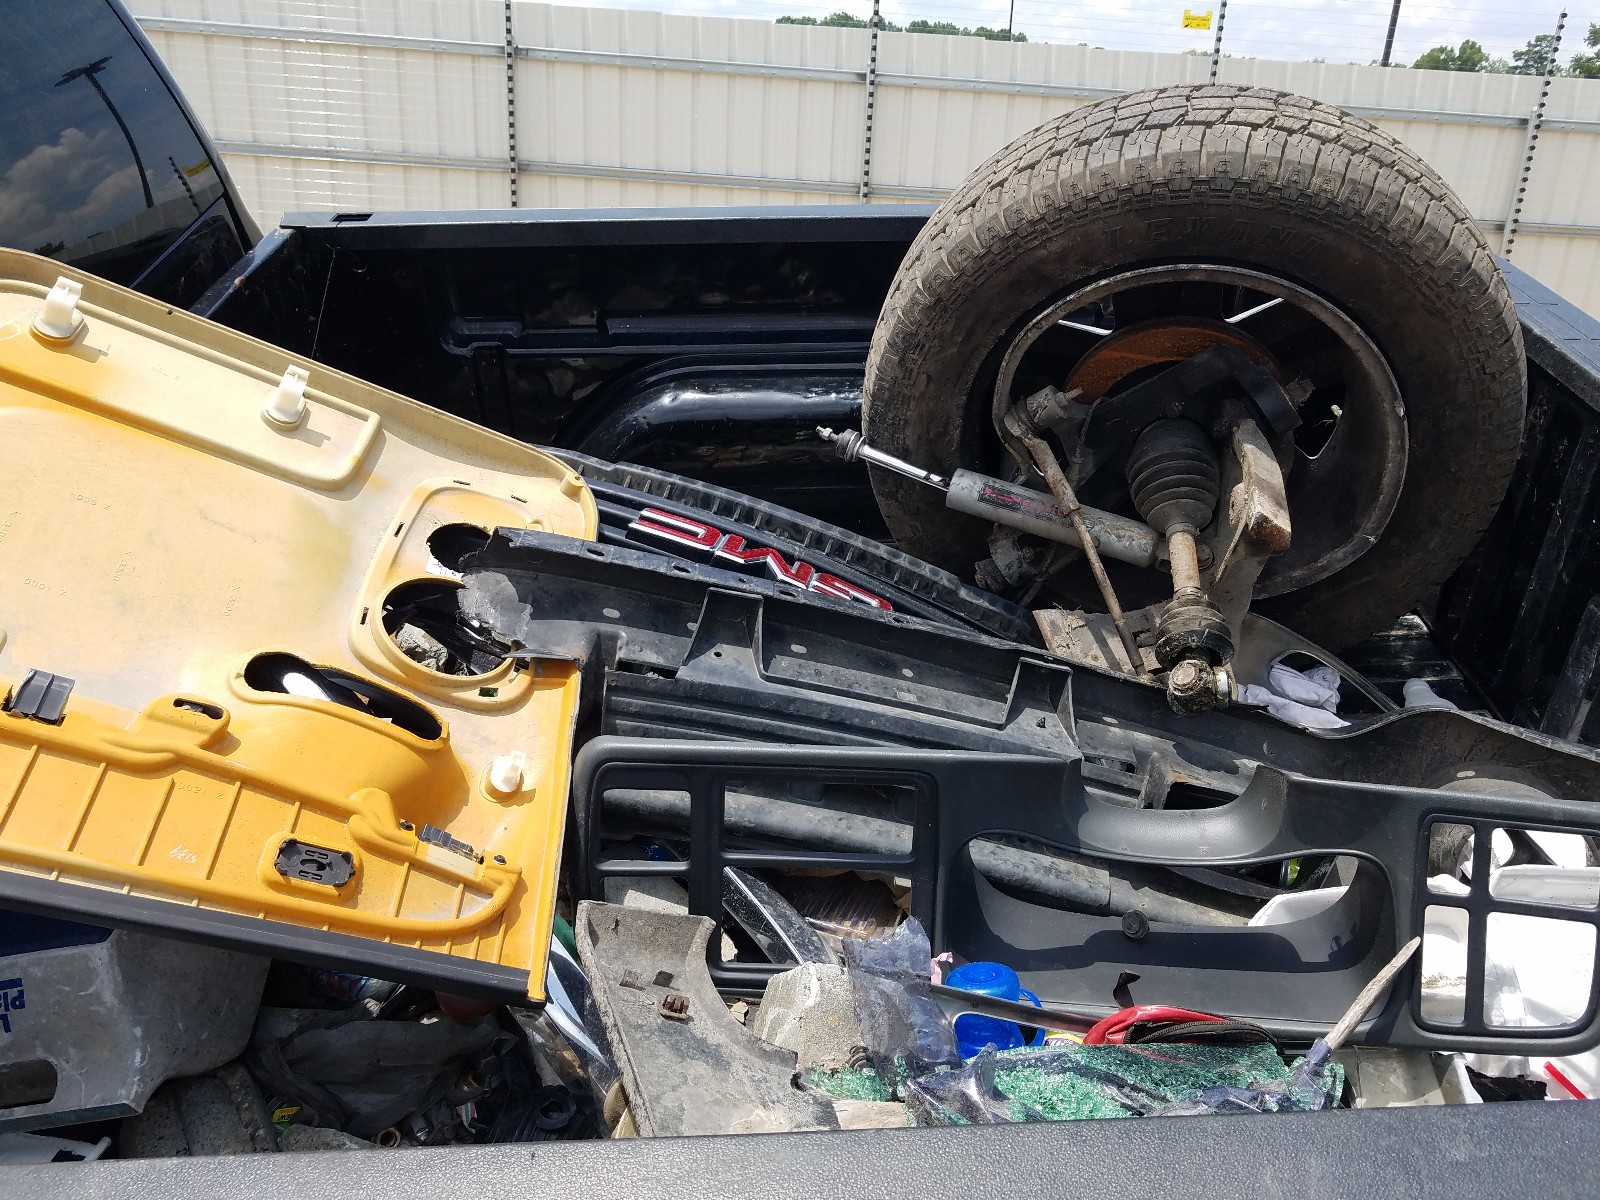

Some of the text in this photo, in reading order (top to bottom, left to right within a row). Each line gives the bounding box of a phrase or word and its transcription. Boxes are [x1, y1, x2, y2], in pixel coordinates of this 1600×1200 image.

[1103, 215, 1324, 256] LEXANI
[628, 506, 893, 611] GMC
[0, 989, 26, 1013] Pl
